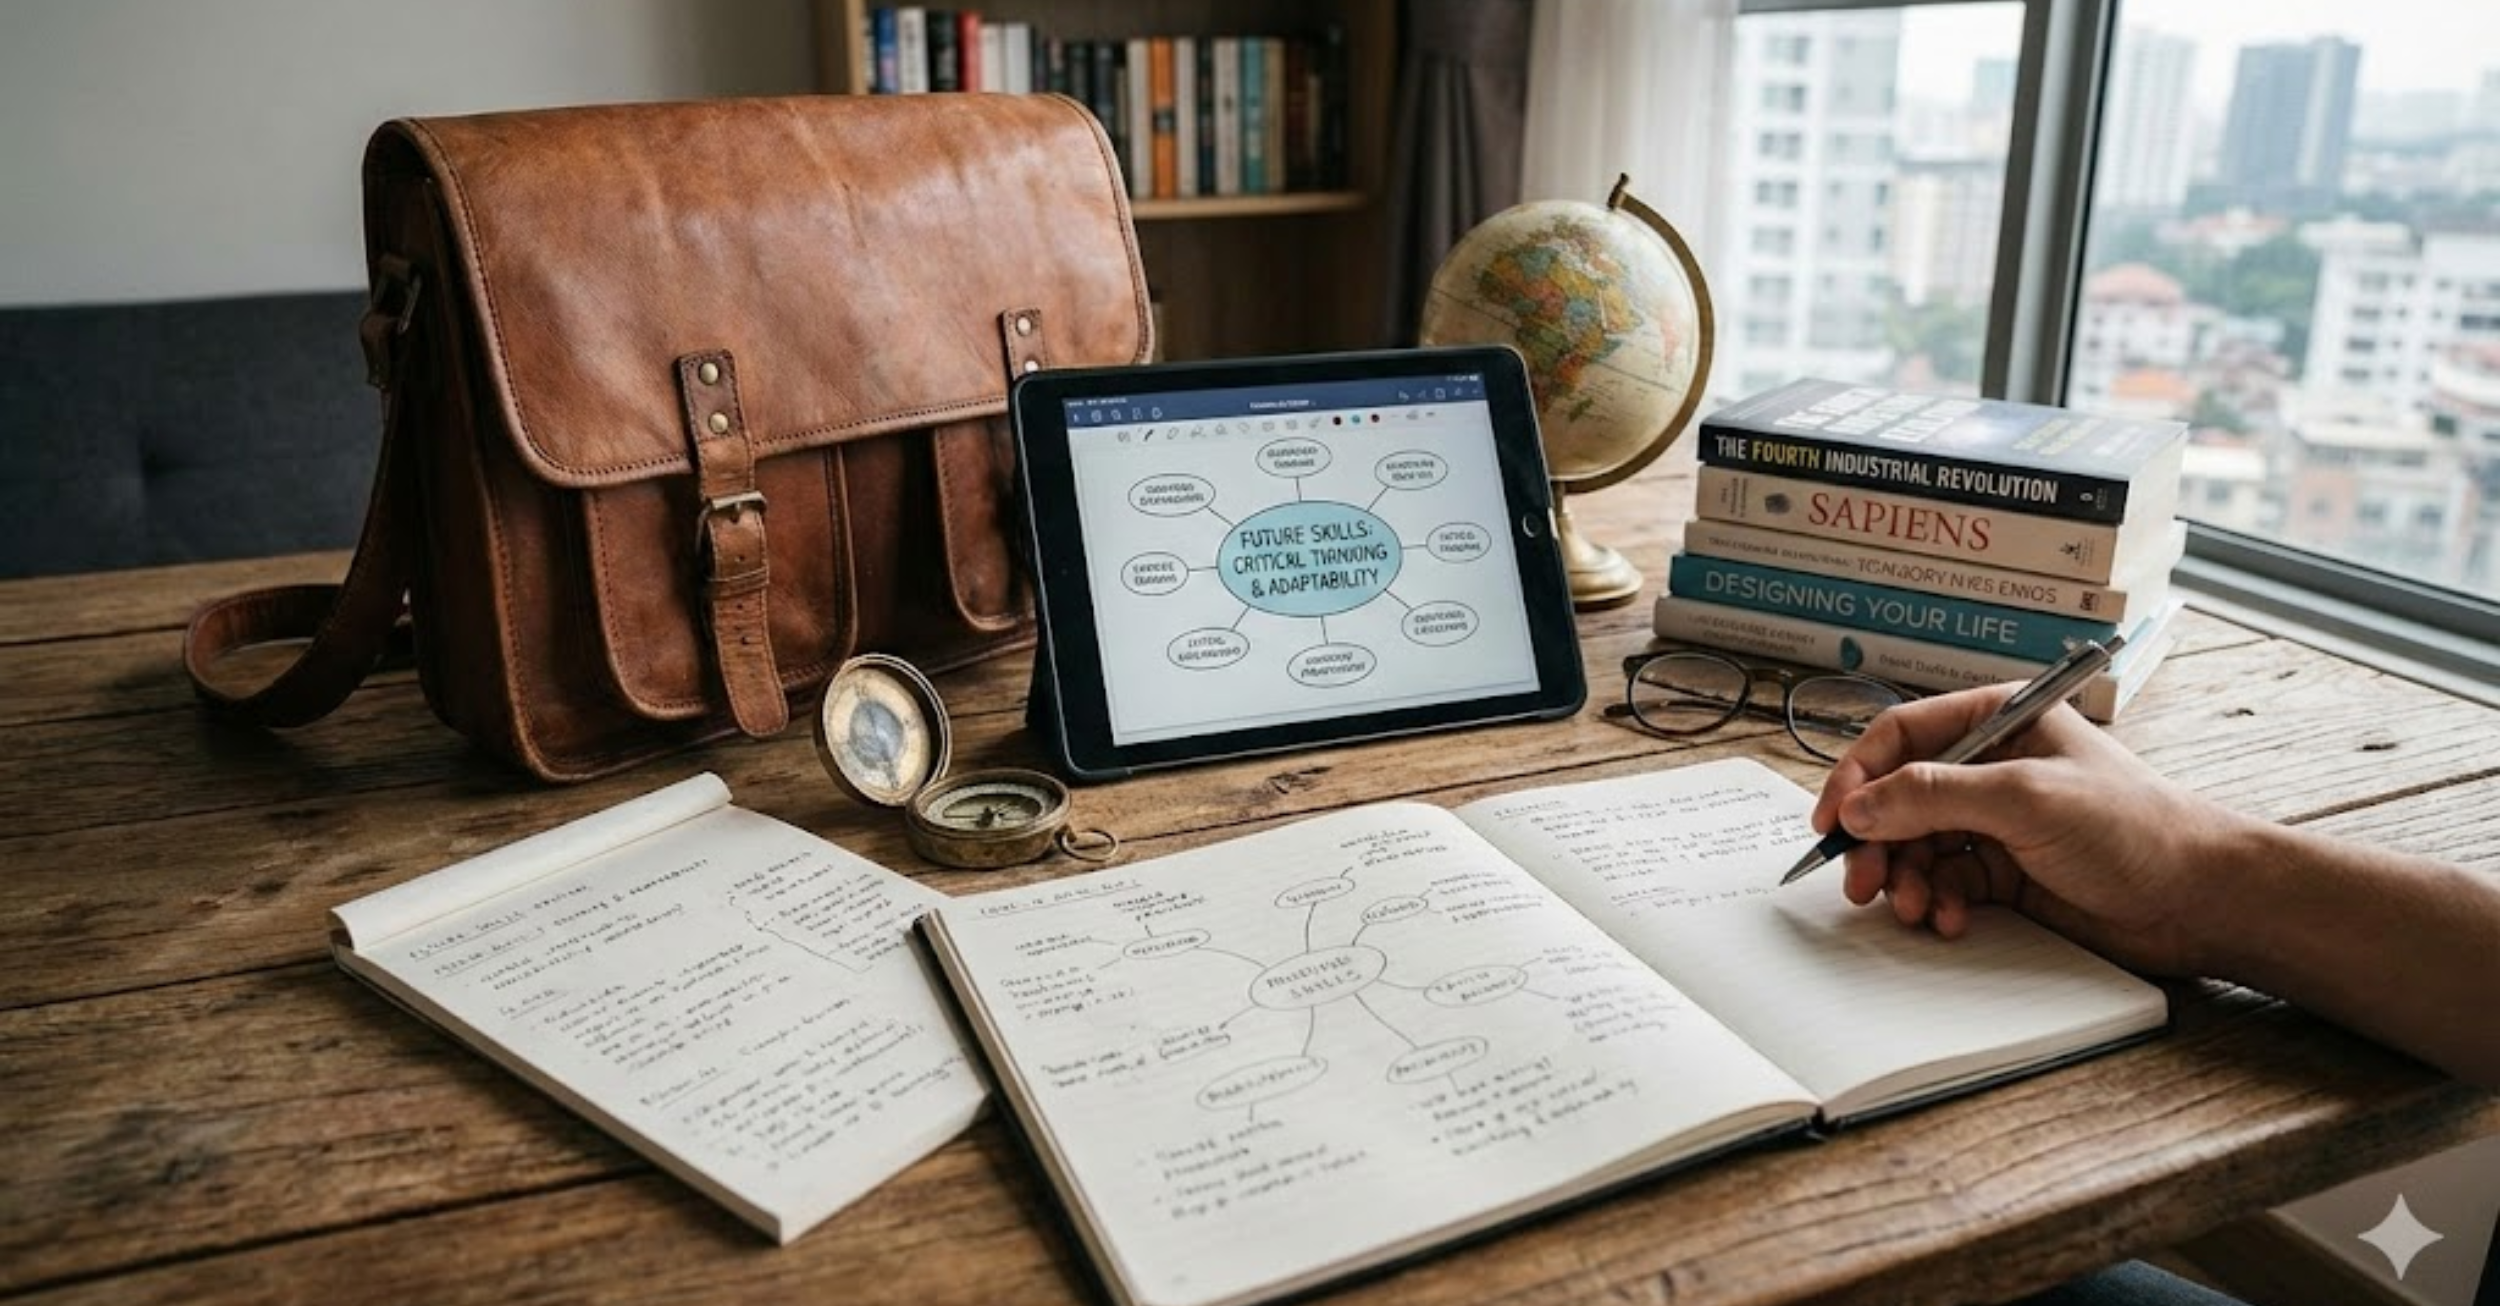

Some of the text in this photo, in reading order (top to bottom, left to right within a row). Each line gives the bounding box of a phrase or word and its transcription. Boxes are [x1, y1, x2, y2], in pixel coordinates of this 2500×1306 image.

[1715, 435, 2058, 504] THE FOURTH INDUSTRIAL REVOLUTION
[1240, 520, 1373, 549] FUTURE SKILLS:
[1808, 492, 1991, 551] SAPIENS
[1233, 551, 1306, 574] CRITICAL
[1252, 568, 1378, 598] & ADAPTABILITY
[1705, 571, 2020, 643] DESIGNING YOUR LIFE
